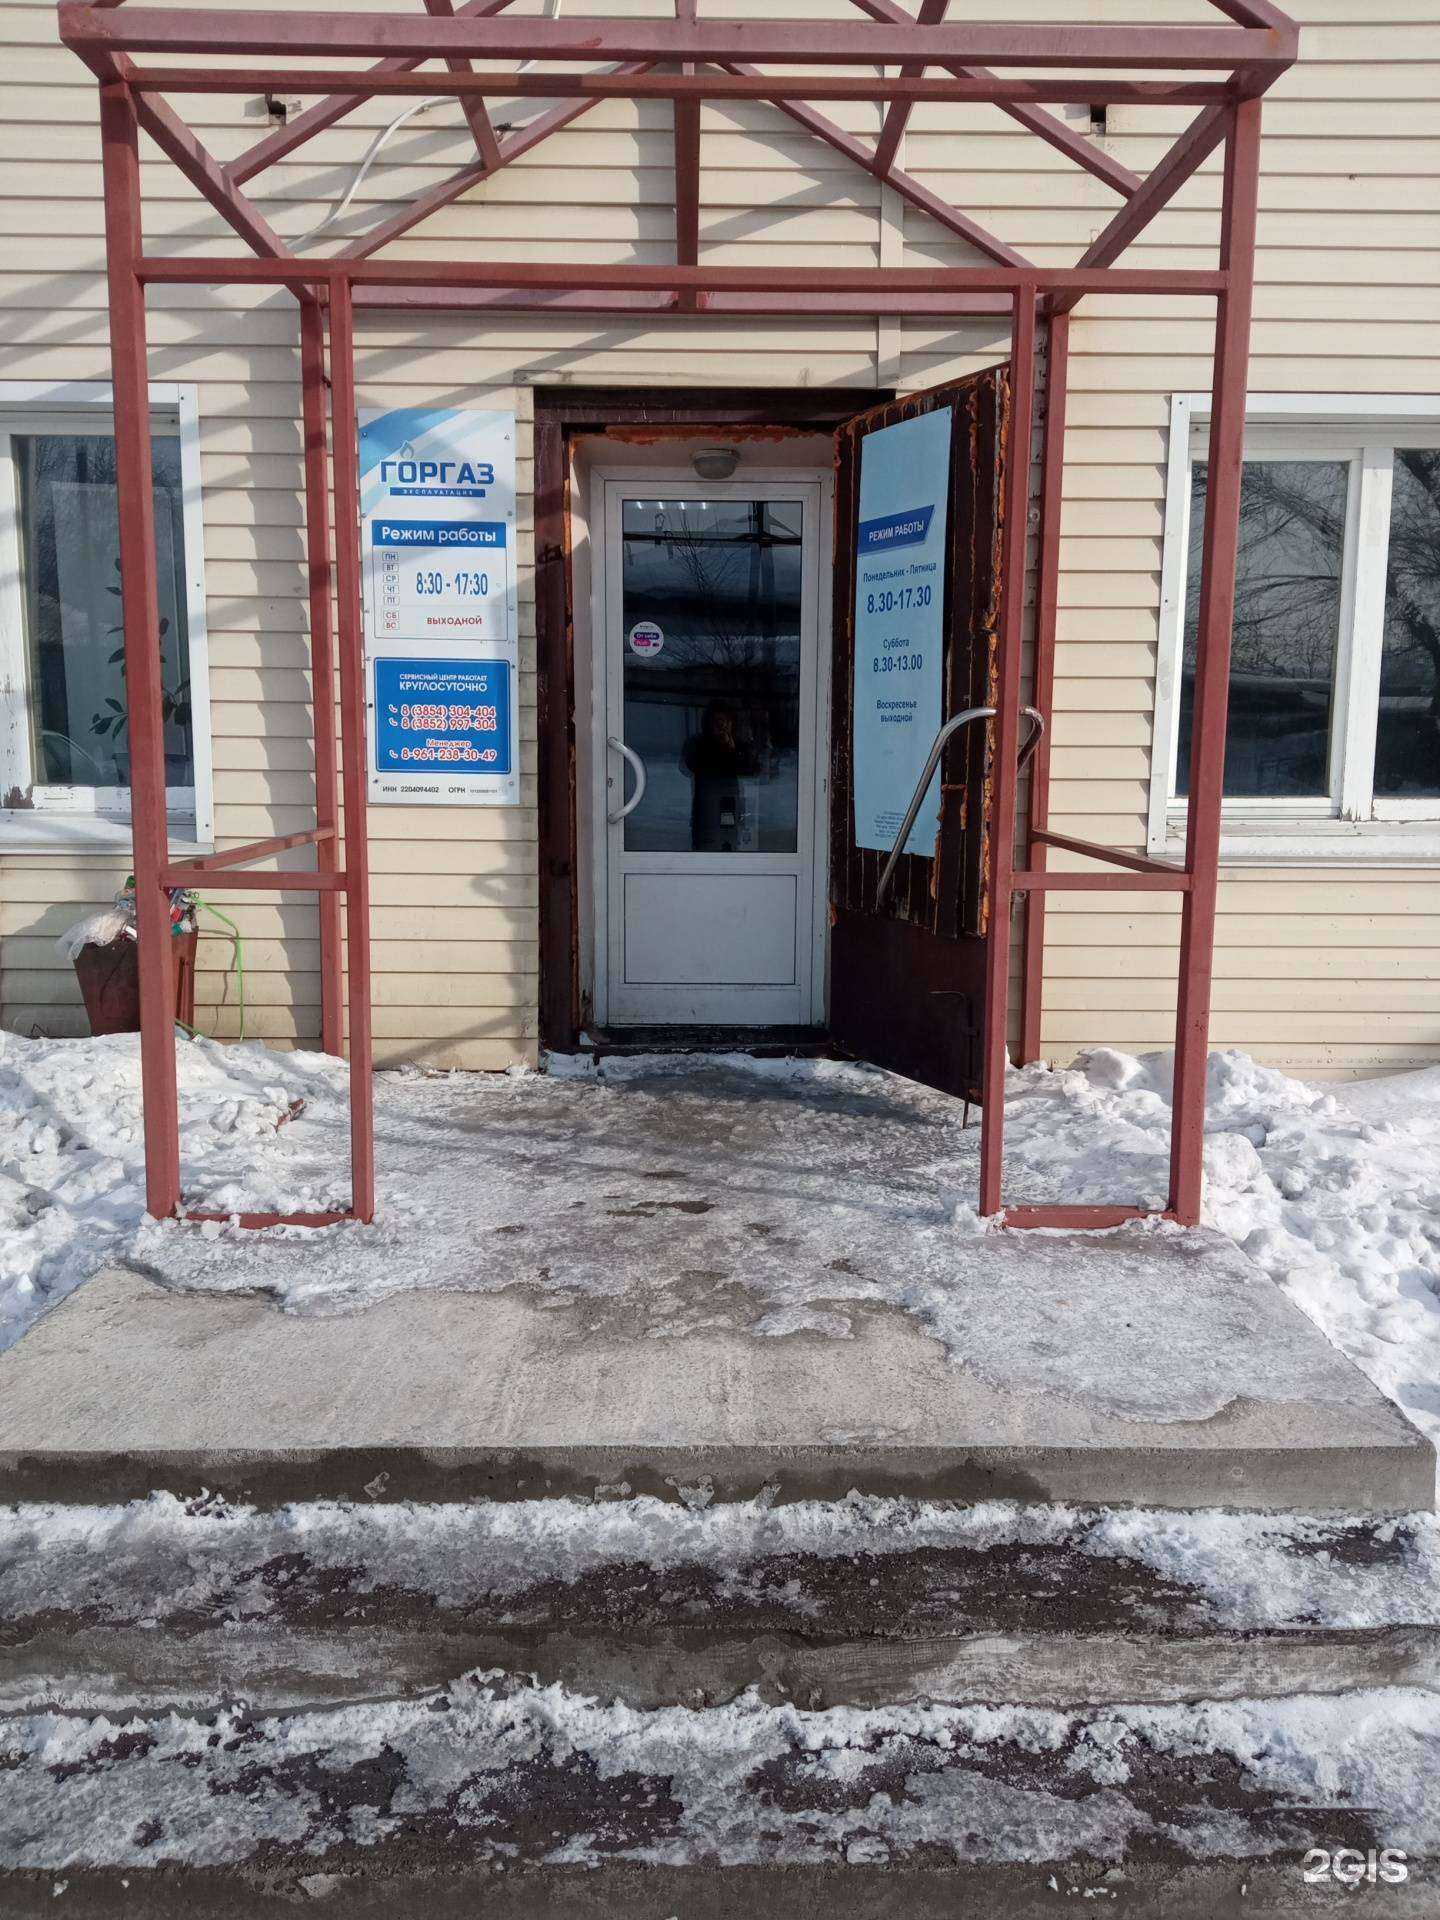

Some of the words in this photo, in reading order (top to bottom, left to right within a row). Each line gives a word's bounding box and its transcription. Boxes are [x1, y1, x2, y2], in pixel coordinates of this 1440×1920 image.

[380, 461, 495, 485] ГОРГАЗ
[382, 526, 434, 540] Режим
[438, 527, 496, 543] работы
[868, 526, 893, 542] РЕЖИМ
[895, 520, 924, 536] РАБОТЫ
[863, 568, 905, 583] Понедельник
[909, 562, 937, 575] Пятница
[416, 572, 443, 595] 8:30
[455, 572, 488, 595] 17:30
[867, 585, 931, 614] 8.30-17.30
[882, 637, 910, 651] Суббота
[873, 654, 923, 673] 8.30-13.00
[399, 672, 438, 681] СЕРВИСНЫЙ
[399, 681, 488, 692] КРУГЛОСУТОЧНО
[401, 704, 410, 716] 8
[411, 704, 447, 718] (3854)
[449, 705, 496, 718] 304-404
[876, 699, 918, 711] Воскресенье
[401, 717, 410, 729] 8
[411, 718, 447, 731] (3852)
[449, 719, 497, 731] 997-304
